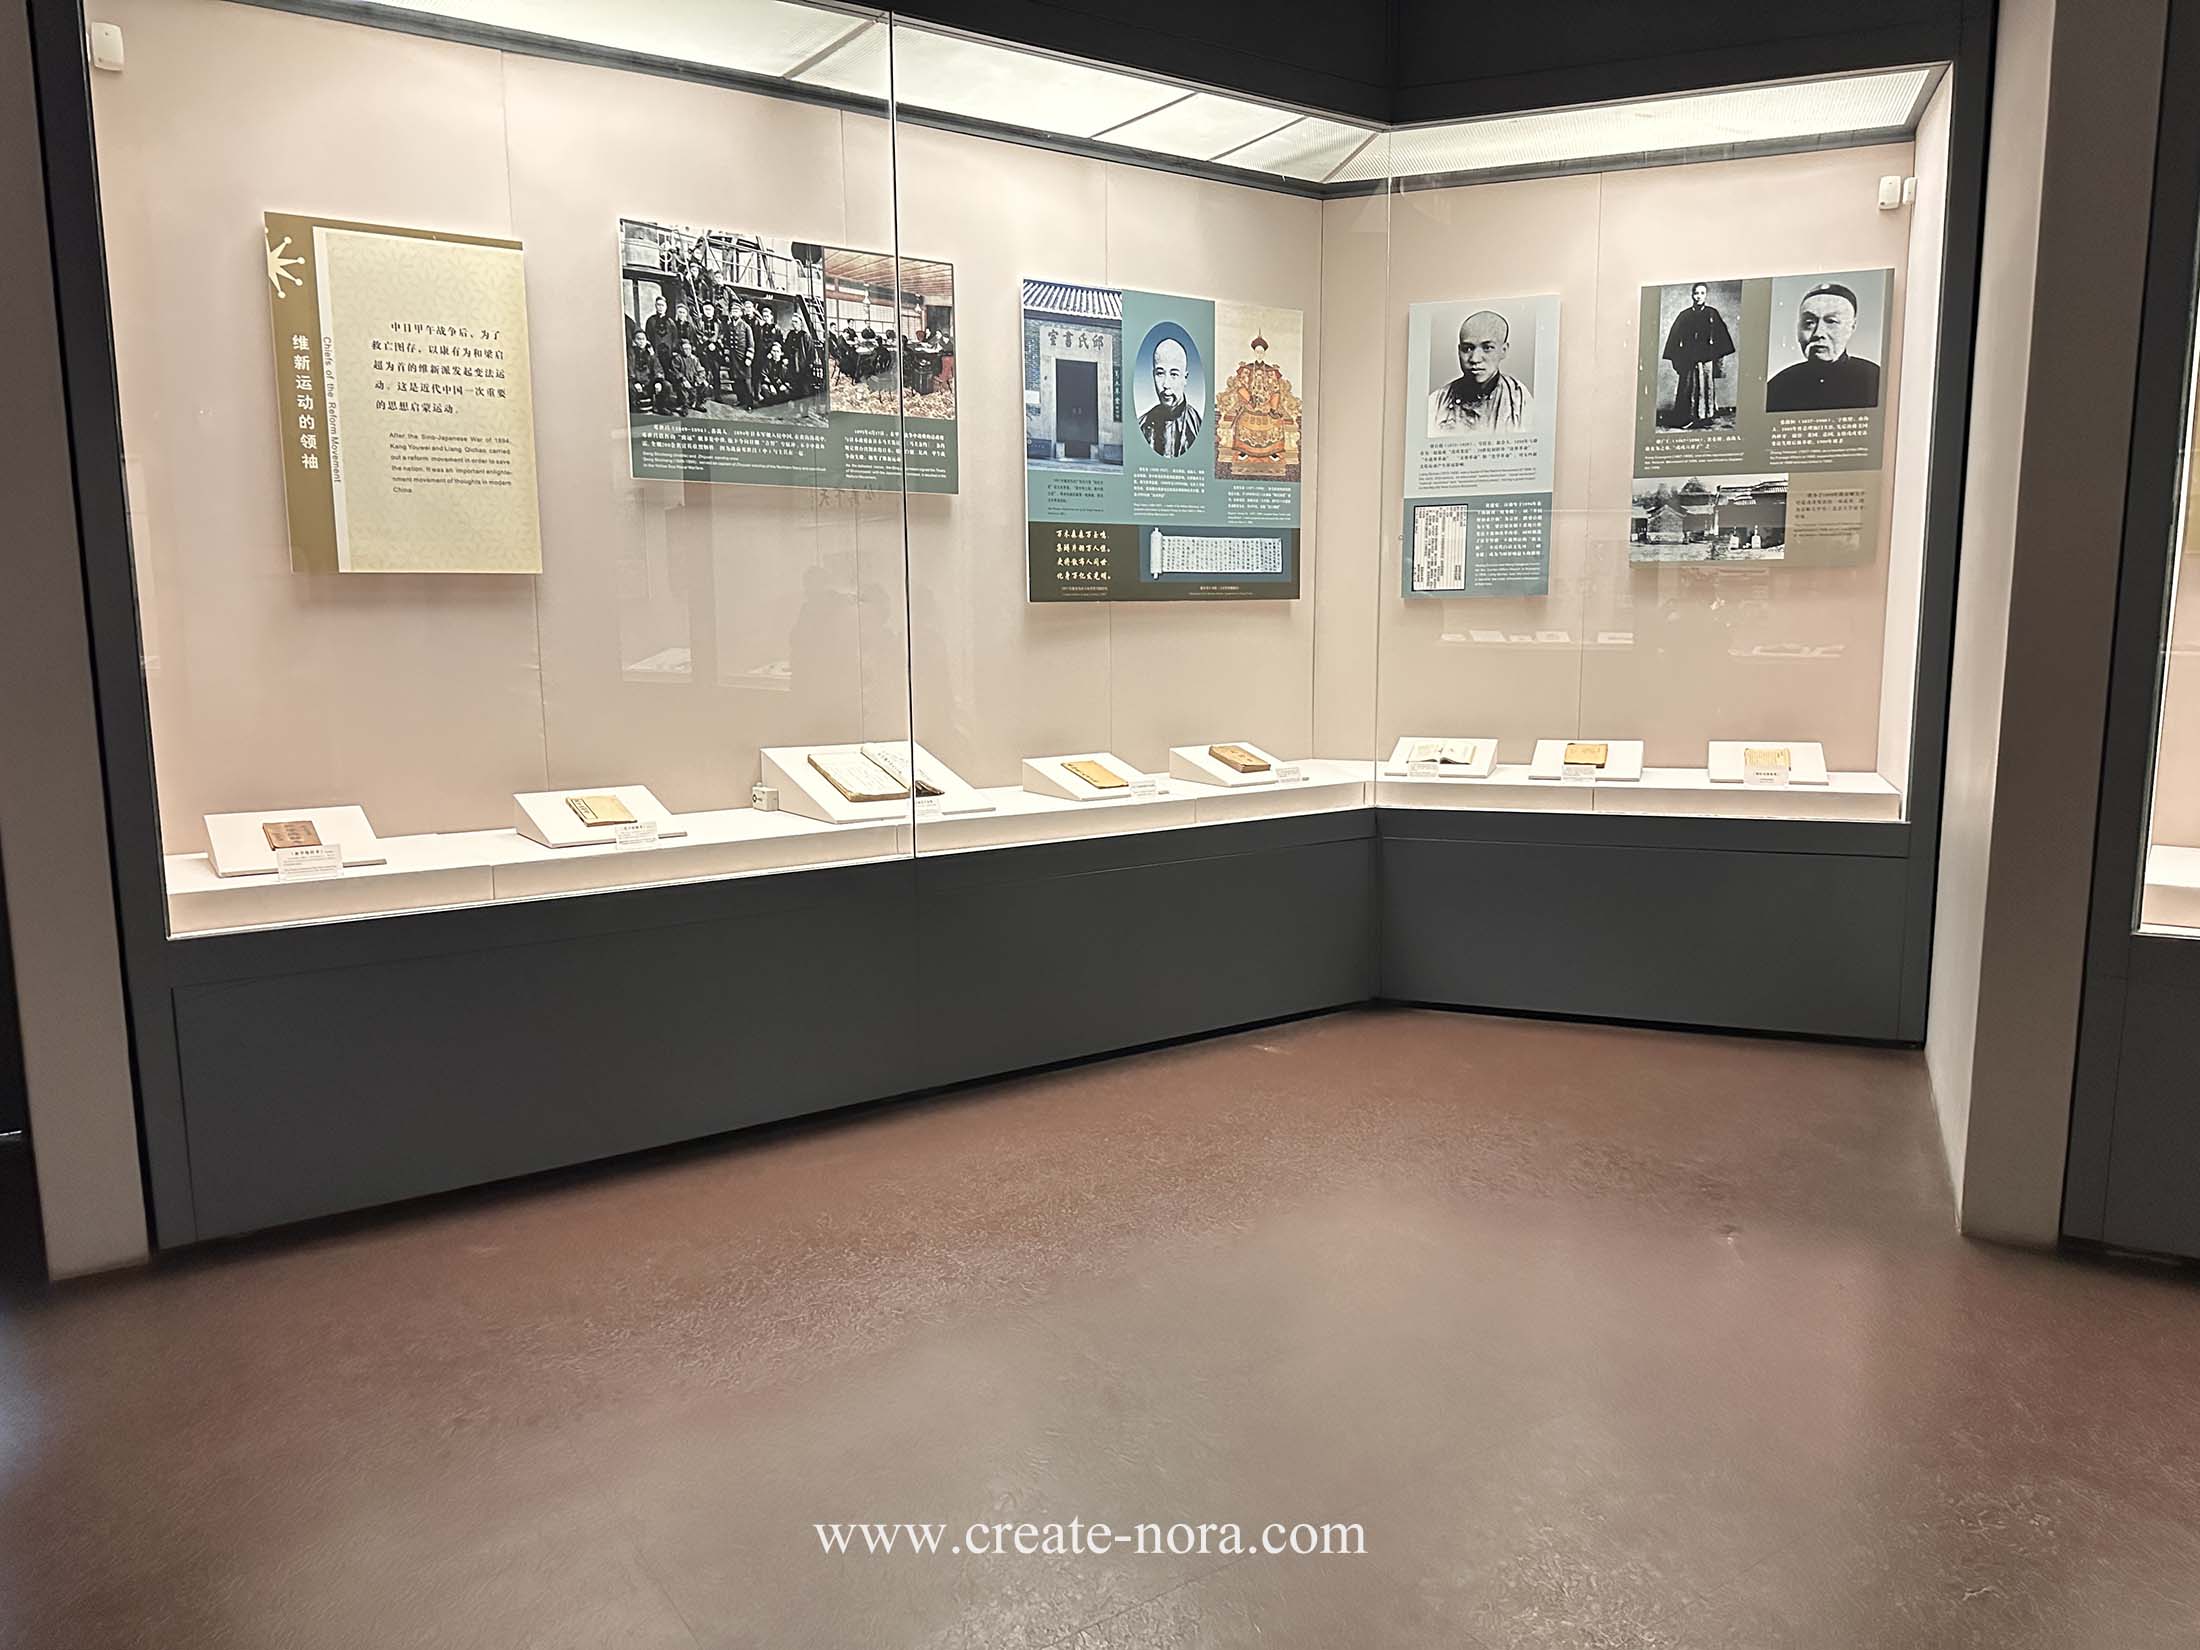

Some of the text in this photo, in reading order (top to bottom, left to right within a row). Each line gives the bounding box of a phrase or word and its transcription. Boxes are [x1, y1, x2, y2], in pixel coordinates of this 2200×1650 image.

[323, 336, 332, 365] Chiefs
[326, 370, 334, 380] of
[292, 335, 319, 469] 维新运动的领袖
[328, 402, 338, 434] Reform
[331, 437, 341, 482] Movement
